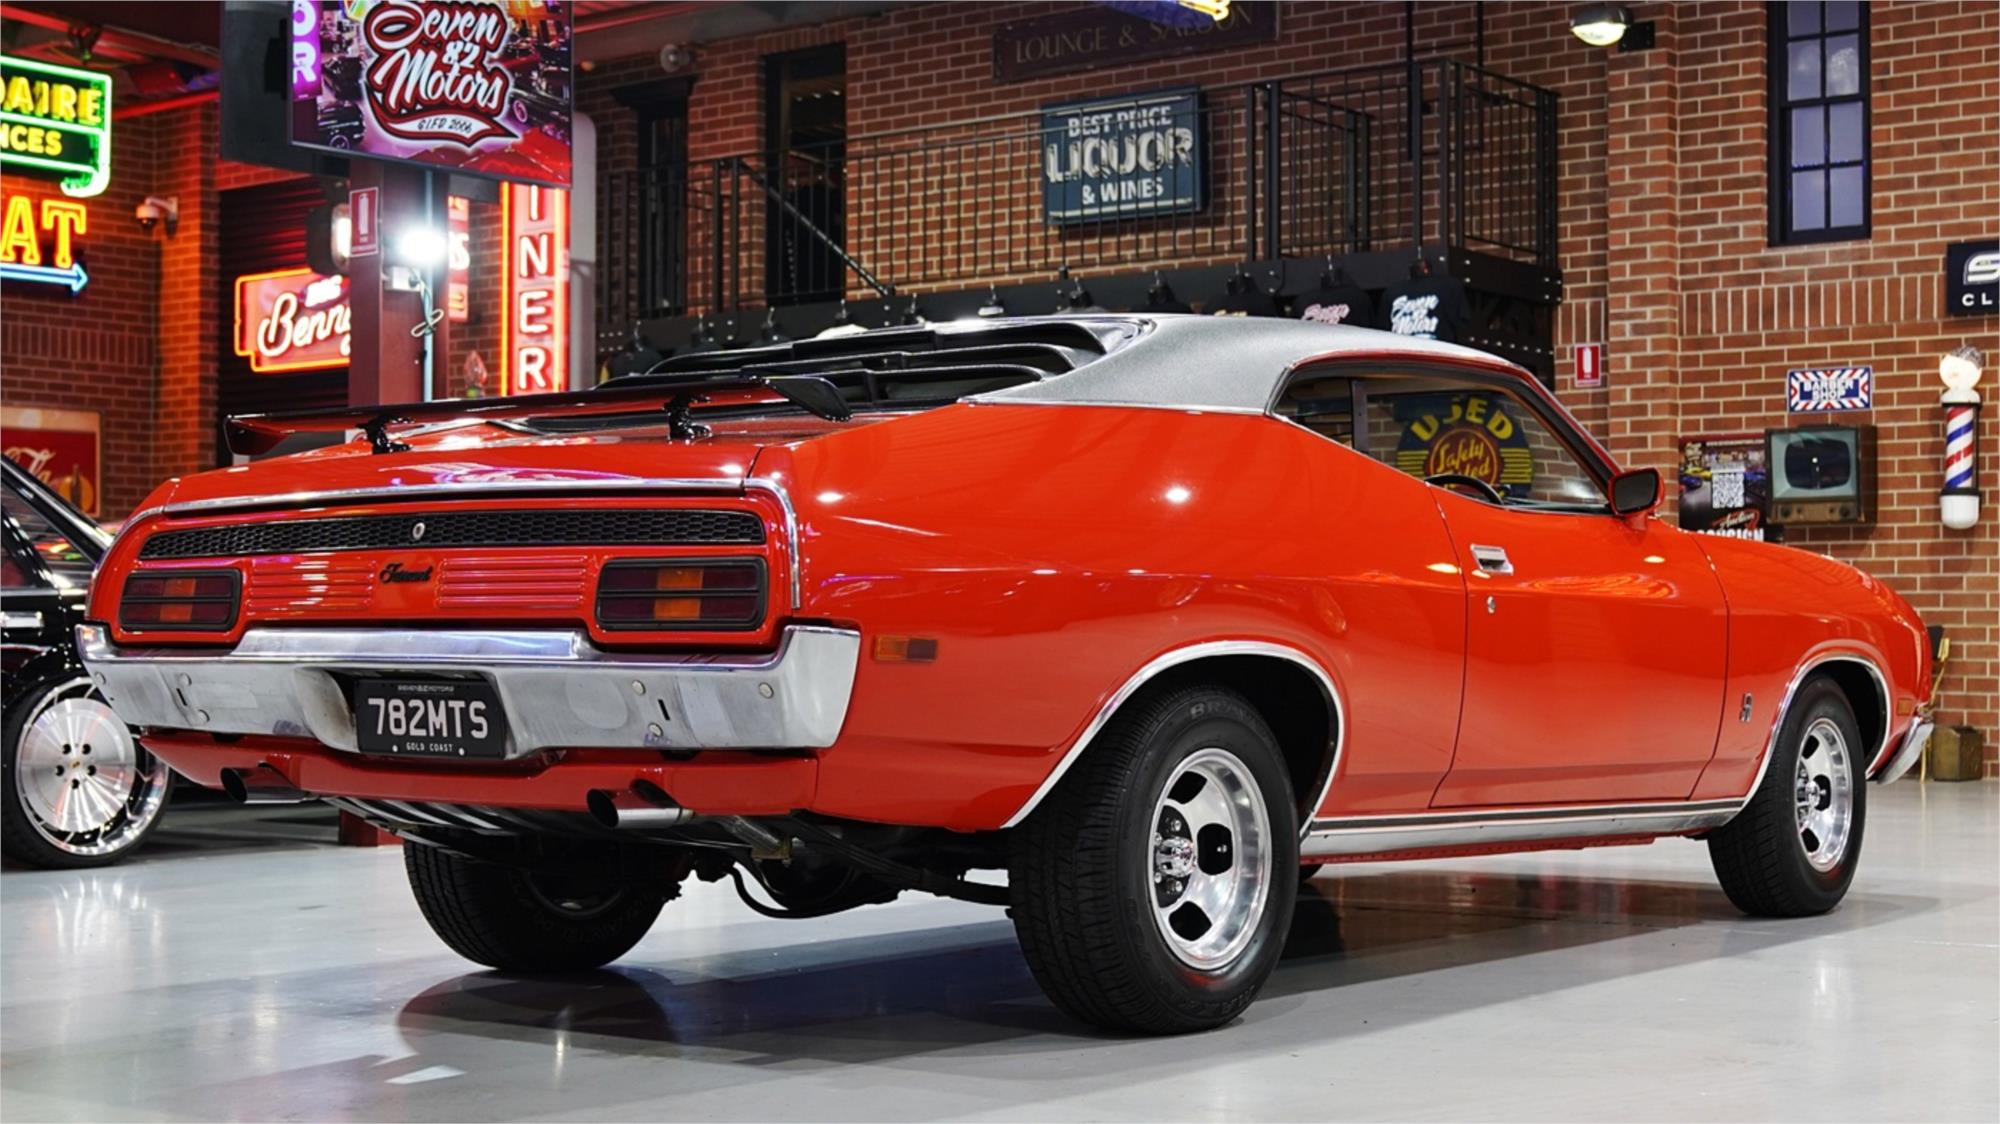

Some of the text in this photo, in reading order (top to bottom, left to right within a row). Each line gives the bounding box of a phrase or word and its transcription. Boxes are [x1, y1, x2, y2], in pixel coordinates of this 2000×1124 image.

[371, 1, 501, 50] Seven
[1015, 27, 1110, 64] LOUNGE
[1118, 24, 1137, 48] &
[441, 40, 481, 68] 82
[373, 47, 503, 110] Motors
[0, 75, 103, 126] AIRE
[1067, 106, 1172, 138] BEST PRICE
[1045, 127, 1194, 184] LIQUOR
[1082, 176, 1165, 206] & WINES
[1802, 379, 1855, 393] BARBER
[1812, 388, 1846, 401] SHOP
[1410, 393, 1514, 442] USED
[1436, 438, 1485, 474] Safety
[367, 697, 488, 739] 782MTS
[406, 741, 454, 753] GOLD COAST
